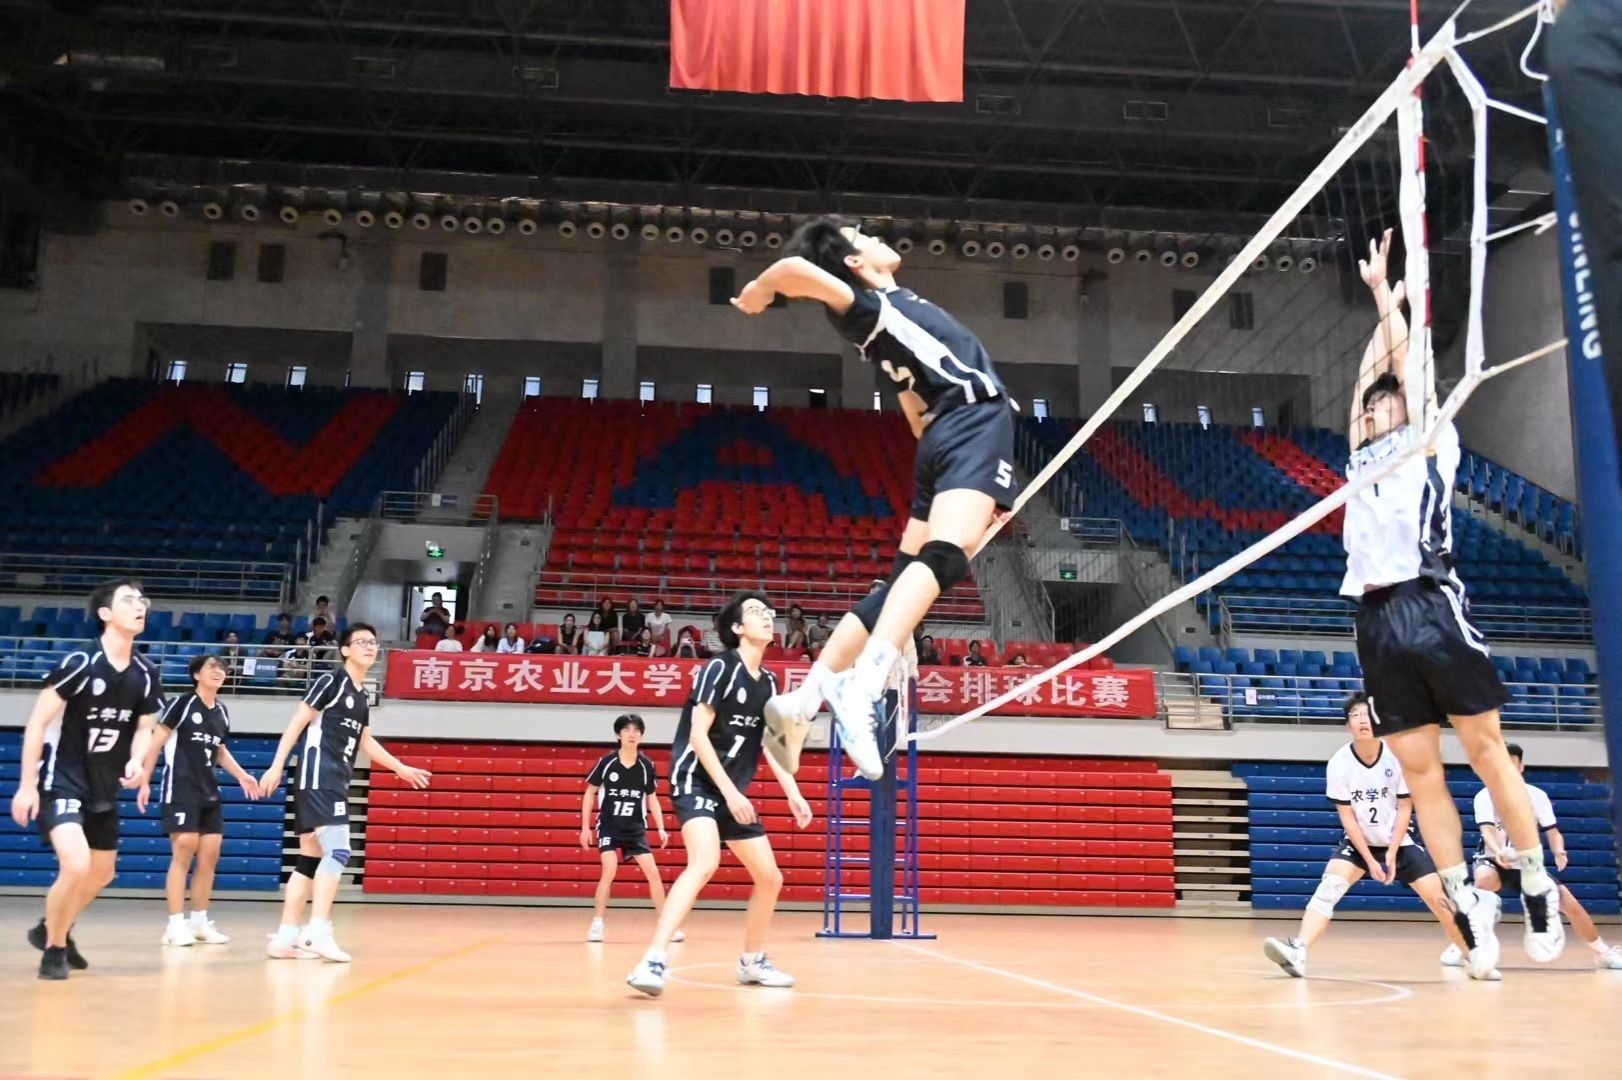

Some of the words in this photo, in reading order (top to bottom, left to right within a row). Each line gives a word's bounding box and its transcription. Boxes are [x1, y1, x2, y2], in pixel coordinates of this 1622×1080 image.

[995, 459, 1012, 488] 5
[87, 728, 120, 753] 13
[608, 788, 641, 799] 工学院
[613, 801, 635, 816] 16
[1369, 807, 1378, 824] 2
[174, 812, 186, 825] 7
